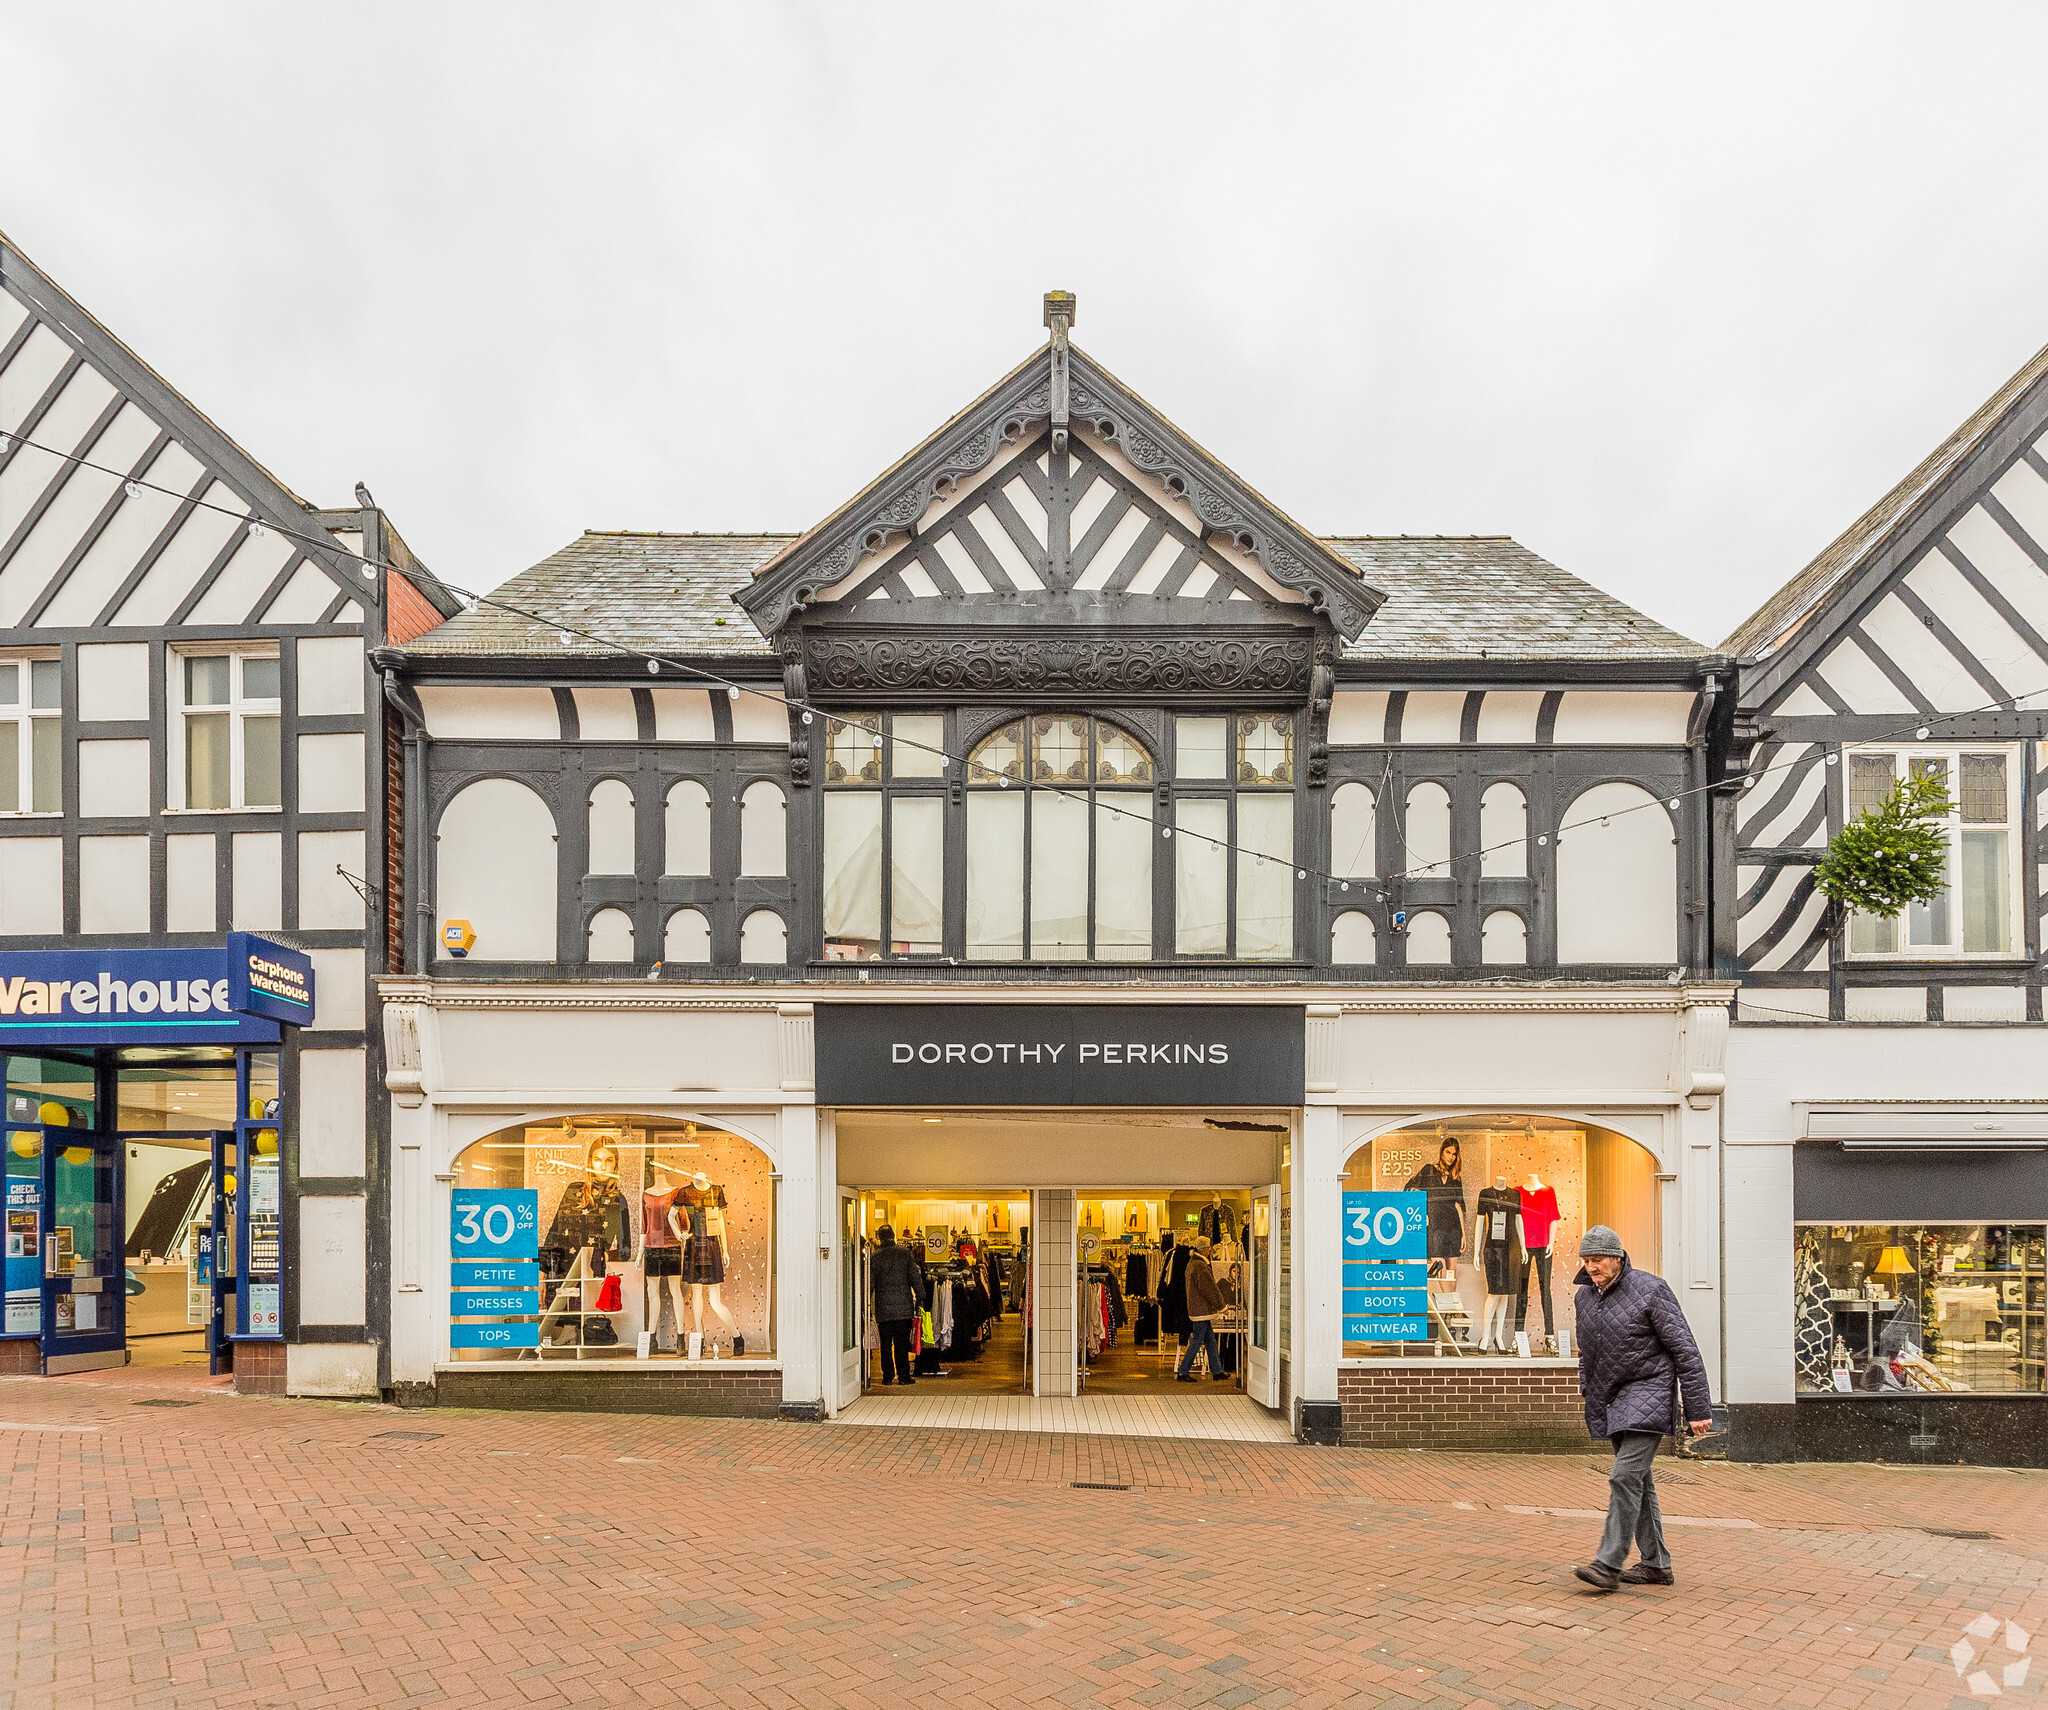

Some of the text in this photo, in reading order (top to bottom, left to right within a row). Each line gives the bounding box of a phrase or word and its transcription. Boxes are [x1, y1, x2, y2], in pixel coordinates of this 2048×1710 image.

[447, 929, 462, 938] ADT
[249, 954, 304, 985] Carphone
[249, 972, 309, 1002] Warehouse
[892, 1043, 1229, 1064] DOROTHY PERKINS
[534, 1149, 566, 1159] KNIT
[1381, 1150, 1422, 1161] DRESS
[534, 1160, 567, 1175] £28
[1381, 1162, 1413, 1176] £25
[10, 1184, 36, 1194] CHECK
[6, 1194, 40, 1205] THIS OUT
[474, 1269, 516, 1280] PETITE
[1364, 1270, 1405, 1281] COATS
[466, 1298, 523, 1309] DRESSES
[1364, 1297, 1406, 1307] BOOTS
[1351, 1323, 1418, 1334] KNITWEAR
[478, 1330, 511, 1341] TOPS
